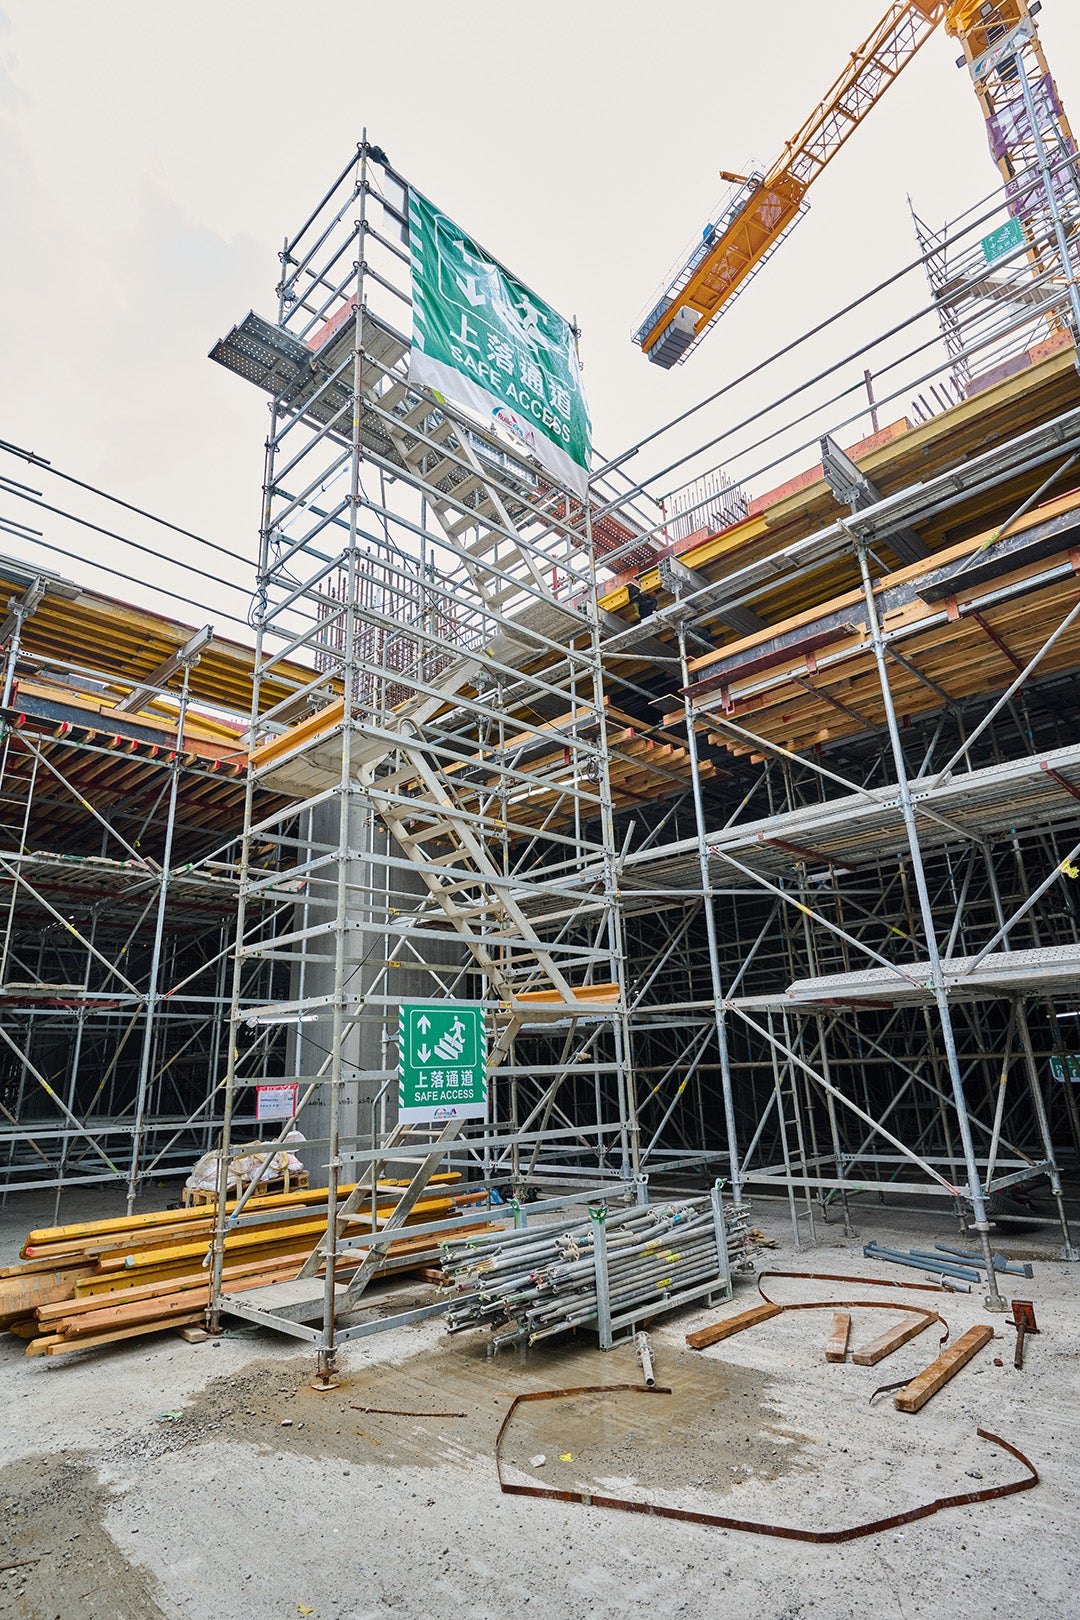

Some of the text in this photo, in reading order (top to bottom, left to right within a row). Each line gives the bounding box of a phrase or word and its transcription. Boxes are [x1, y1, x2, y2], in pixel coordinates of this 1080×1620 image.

[450, 313, 571, 421] 上落通道
[451, 345, 502, 391] SAFE
[506, 383, 571, 443] ACCESS
[414, 1070, 473, 1088] 上落通道
[414, 1089, 474, 1102] SAFE ACCESS
